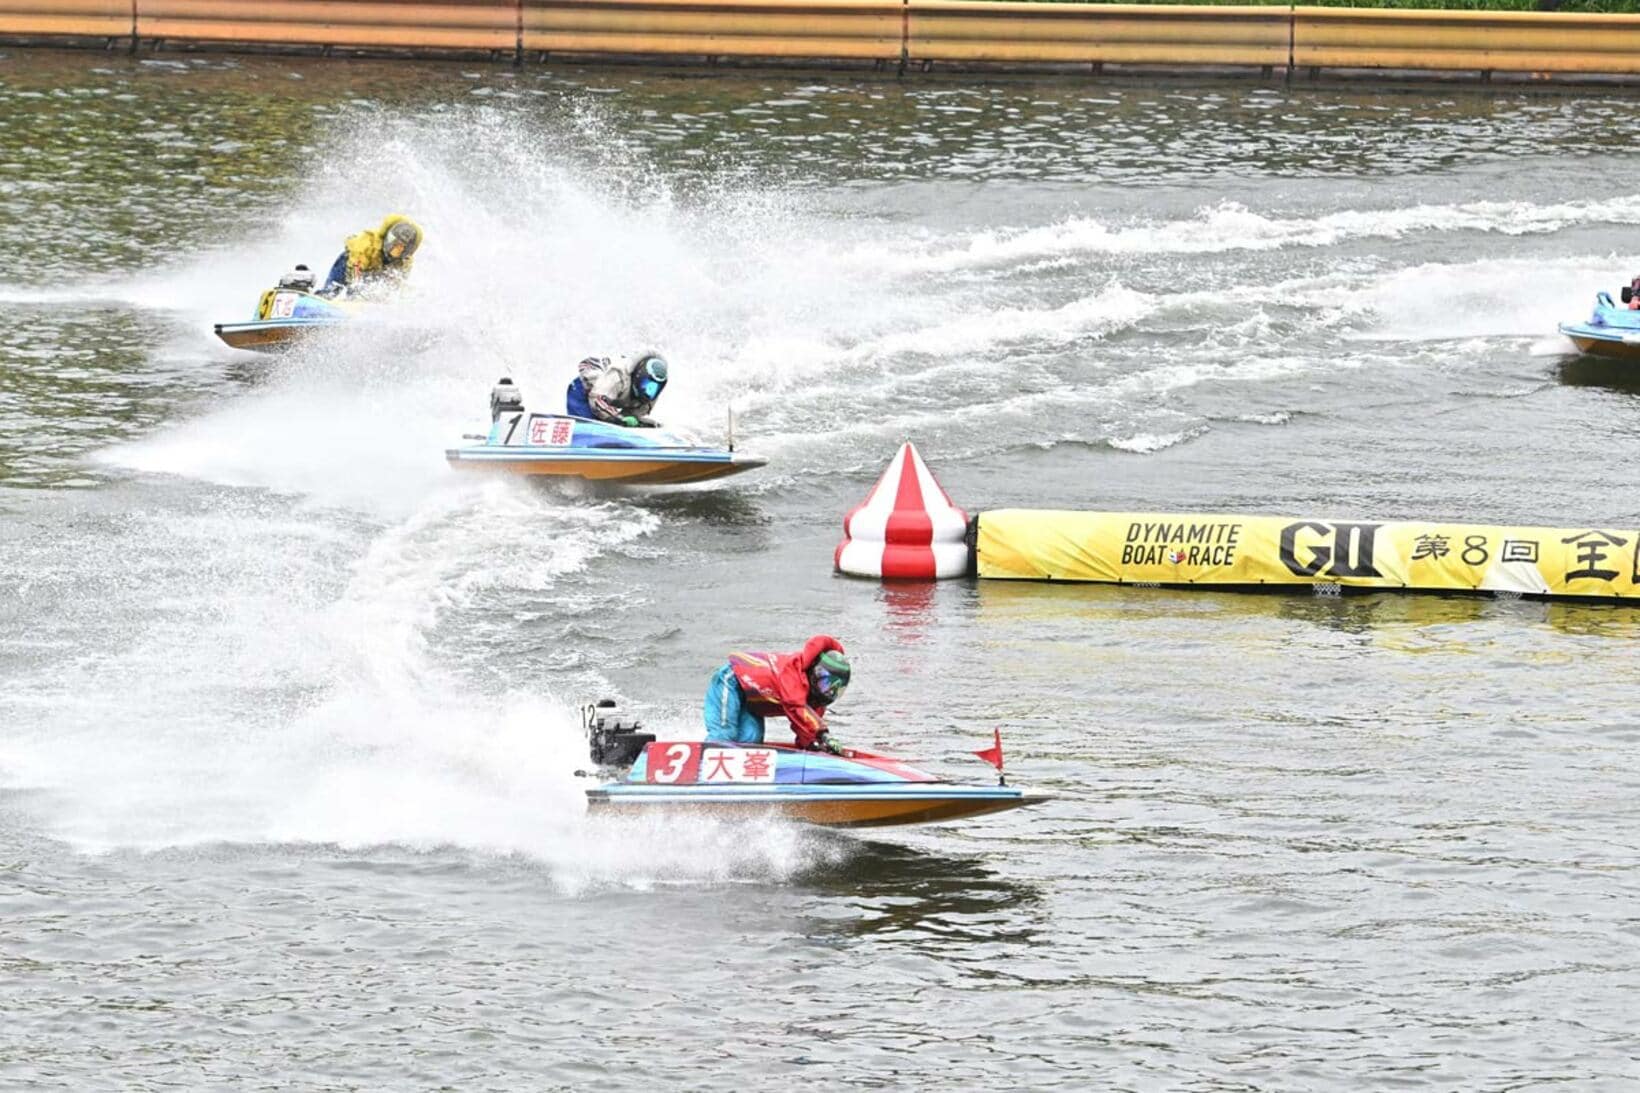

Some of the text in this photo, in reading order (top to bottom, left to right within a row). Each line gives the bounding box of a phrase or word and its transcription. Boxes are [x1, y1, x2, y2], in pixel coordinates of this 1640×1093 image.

[504, 414, 572, 445] 1 佐藤
[1126, 522, 1243, 544] DYNAMITE
[1121, 545, 1237, 566] BOAT RACE
[1561, 530, 1640, 585] 全
[654, 743, 692, 783] 3
